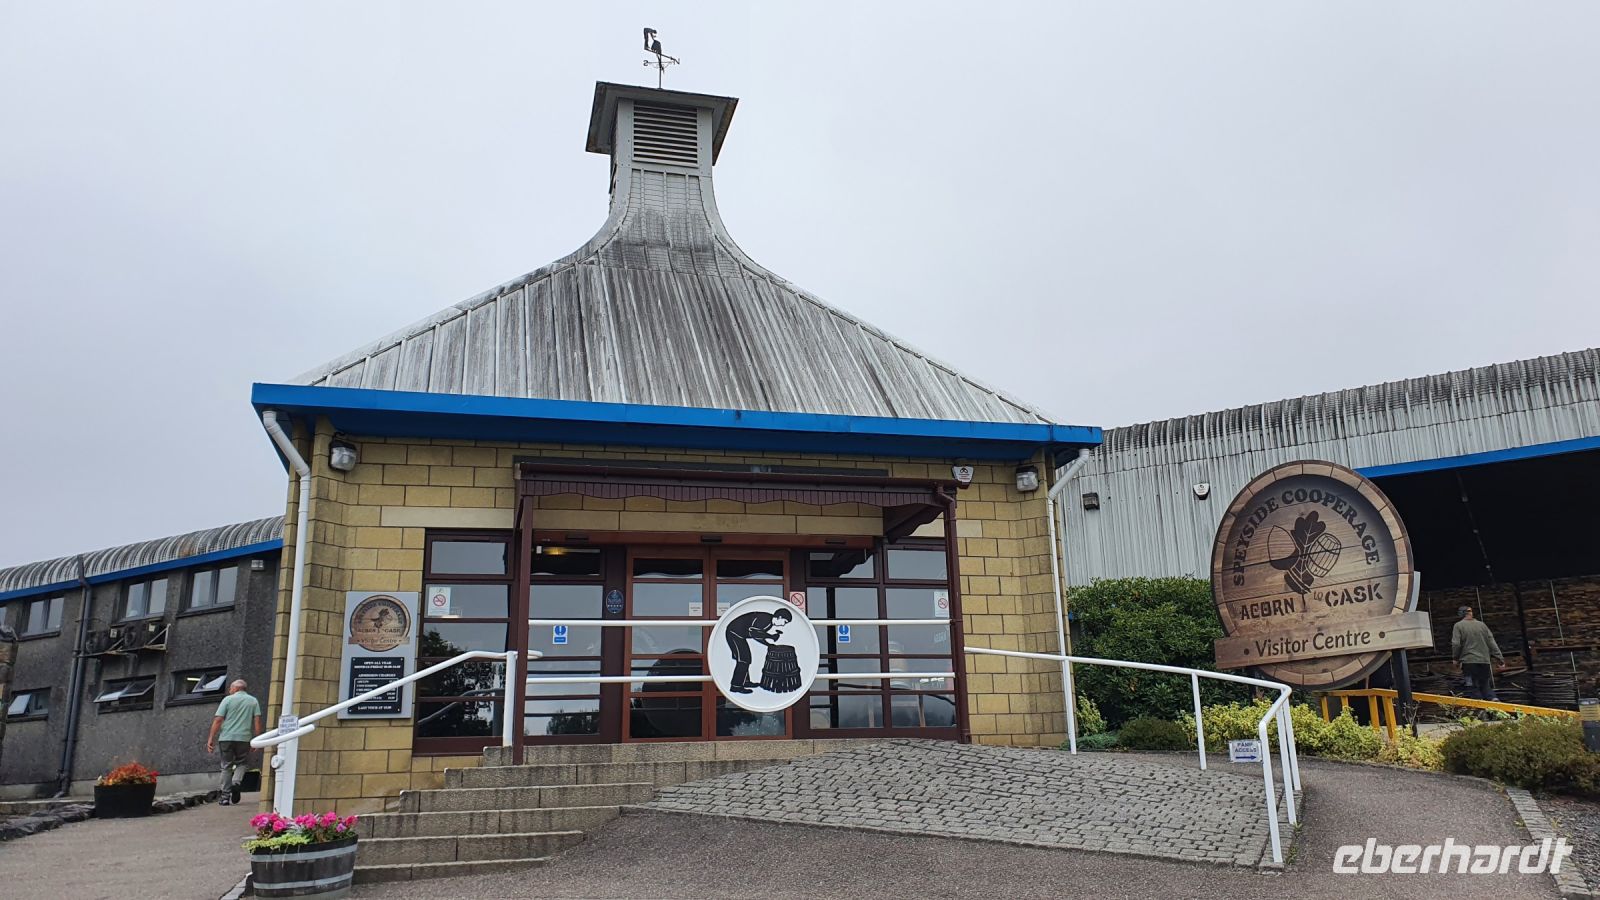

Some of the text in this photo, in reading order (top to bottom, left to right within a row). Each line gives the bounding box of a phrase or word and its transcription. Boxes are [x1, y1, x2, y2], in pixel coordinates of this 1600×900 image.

[1232, 488, 1381, 587] SPEYSIDE COOPERAGE
[1240, 582, 1384, 621] ACORN to CASK
[1255, 630, 1371, 658] Visitor Centre
